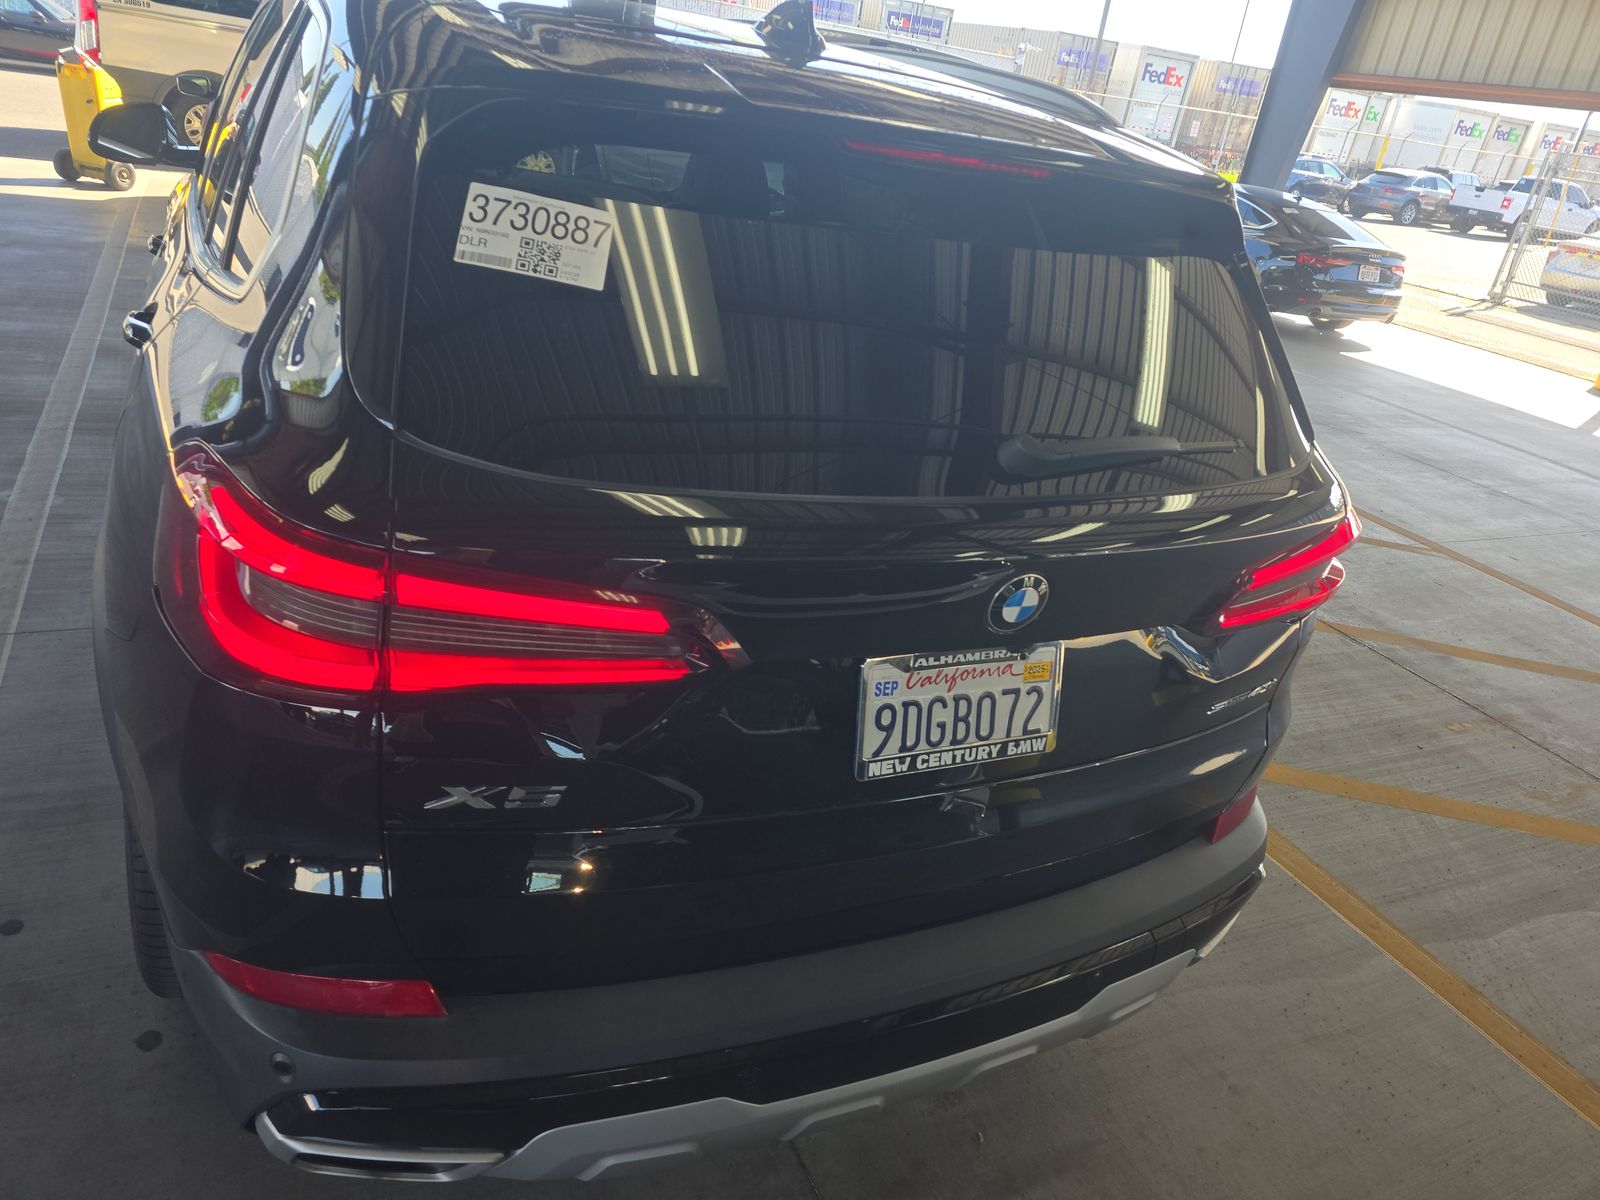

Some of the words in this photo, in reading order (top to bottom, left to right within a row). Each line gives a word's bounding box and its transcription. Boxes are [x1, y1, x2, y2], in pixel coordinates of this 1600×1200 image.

[1141, 62, 1184, 88] FedEx
[1326, 97, 1361, 119] FedEx
[1454, 119, 1485, 140] FedEx
[1492, 124, 1520, 144] FedEx
[1540, 134, 1563, 153] FedE
[468, 193, 612, 249] 3730887
[459, 234, 488, 249] DLR
[874, 680, 899, 698] SEP
[906, 663, 1024, 693] California
[871, 685, 1044, 758] 9DGB072
[868, 757, 912, 778] NEW
[916, 743, 1003, 770] CENTURY
[423, 785, 568, 810] X5
